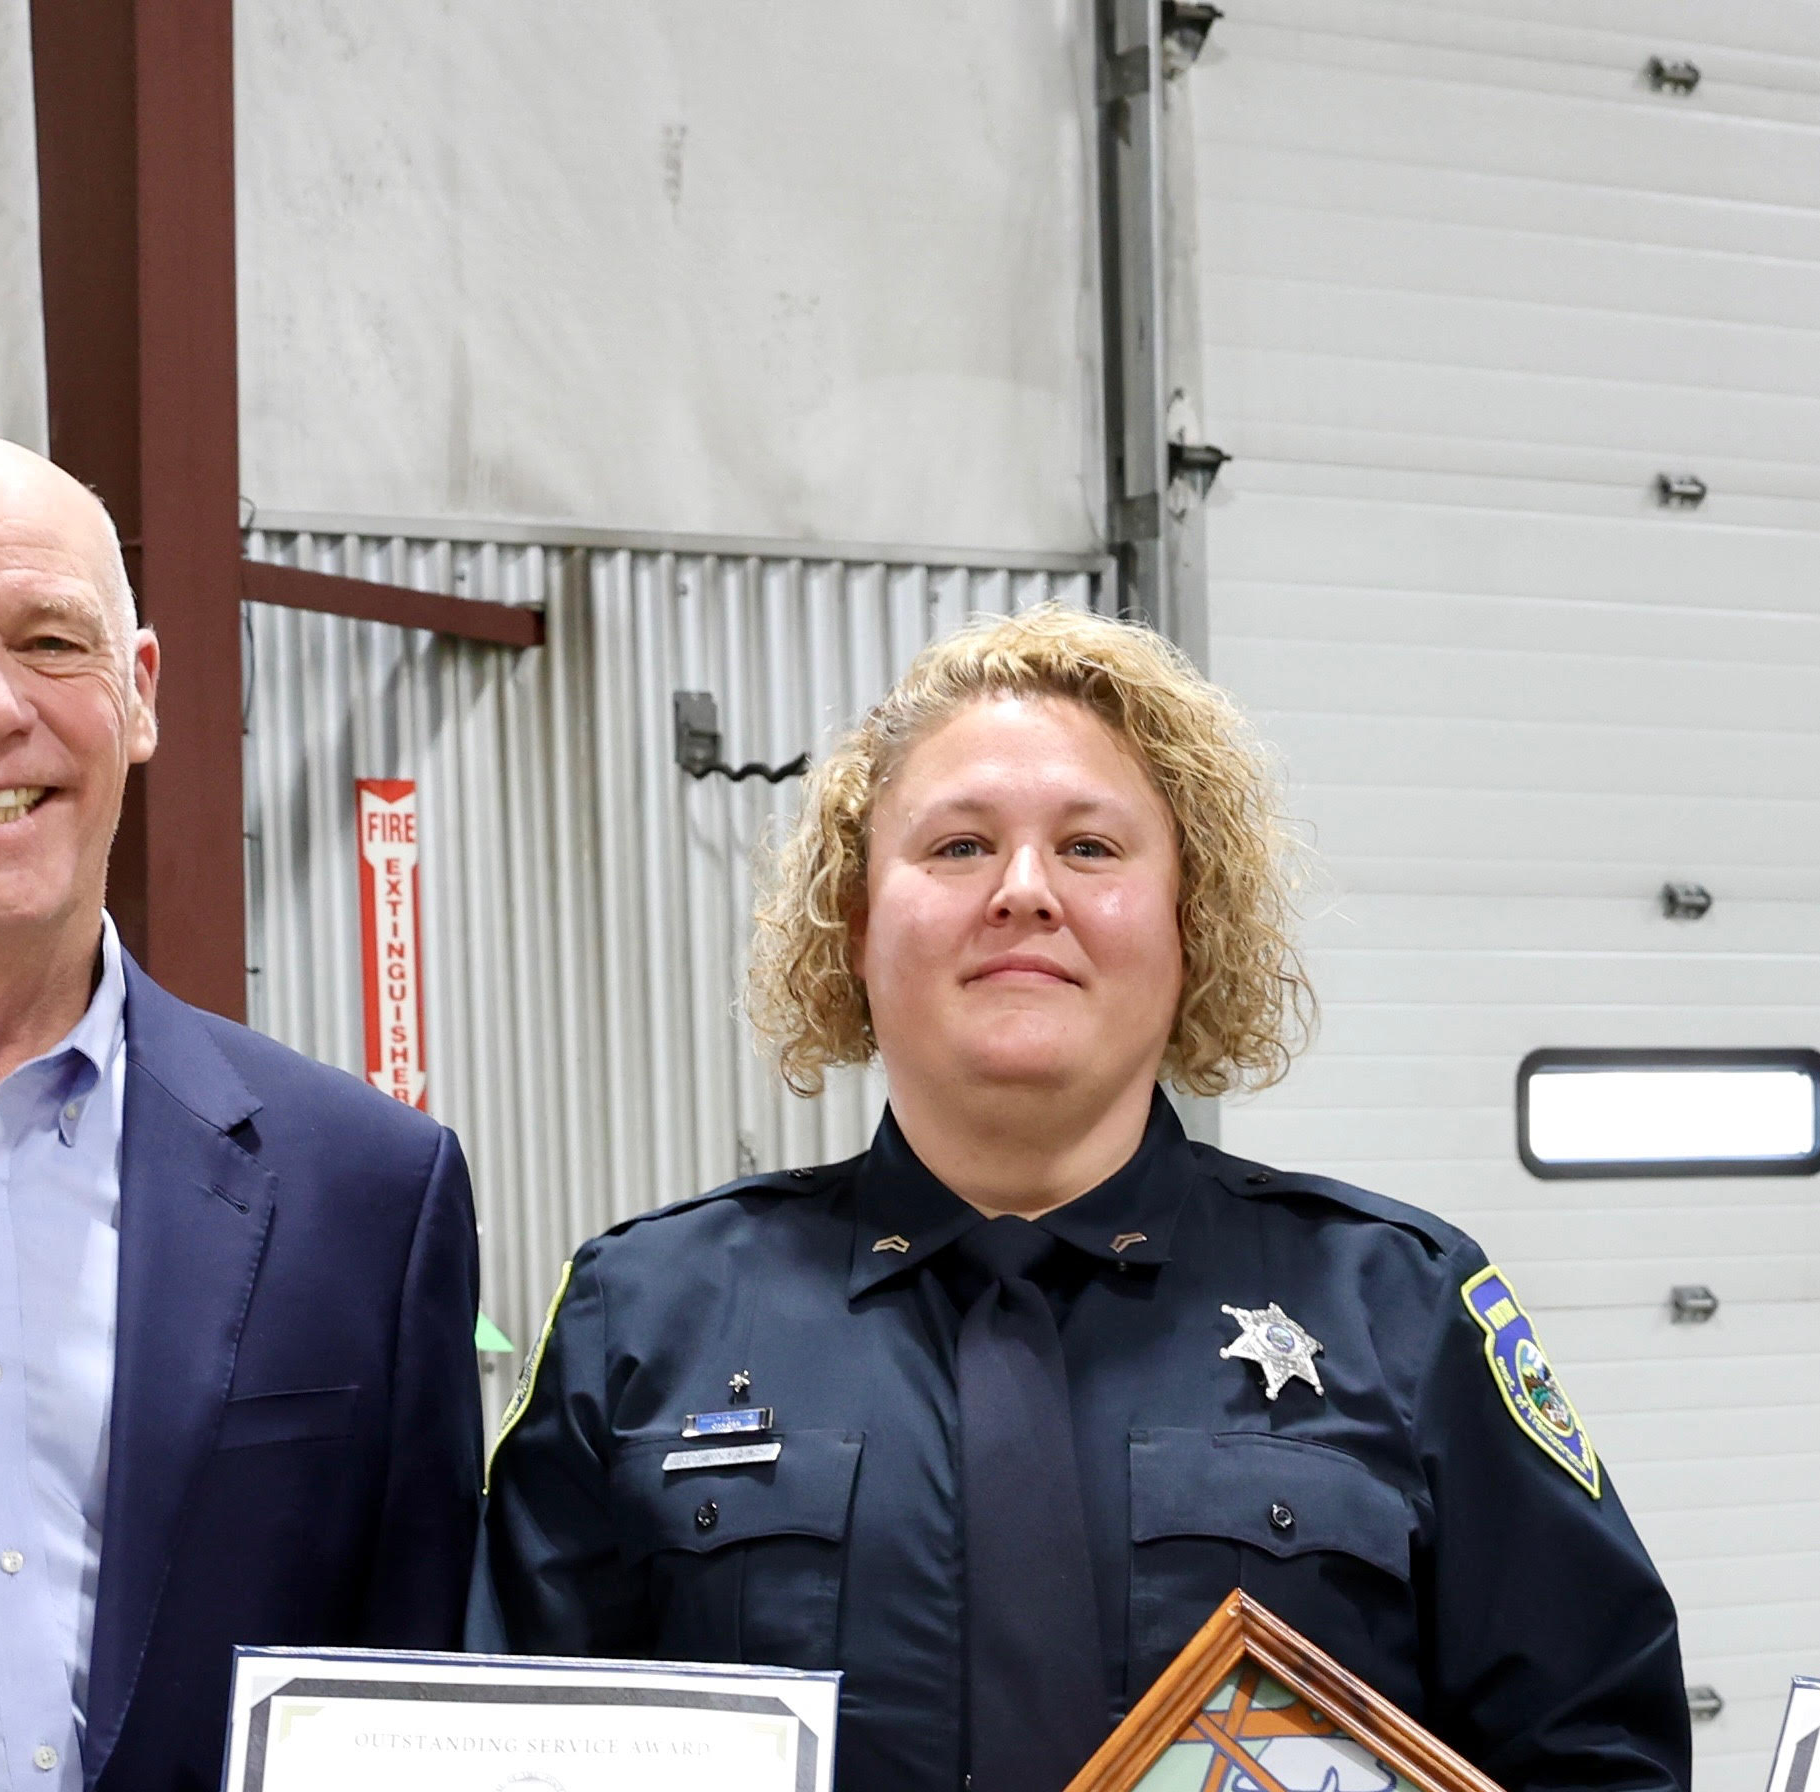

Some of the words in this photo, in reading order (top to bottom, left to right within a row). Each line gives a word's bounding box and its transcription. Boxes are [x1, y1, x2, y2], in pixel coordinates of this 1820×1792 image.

[368, 813, 416, 843] FIRE
[386, 858, 411, 1103] EXTINGUISHER
[355, 1732, 518, 1753] OUTSTANDING
[527, 1738, 619, 1754] SERVICE
[632, 1739, 711, 1756] AWARD
